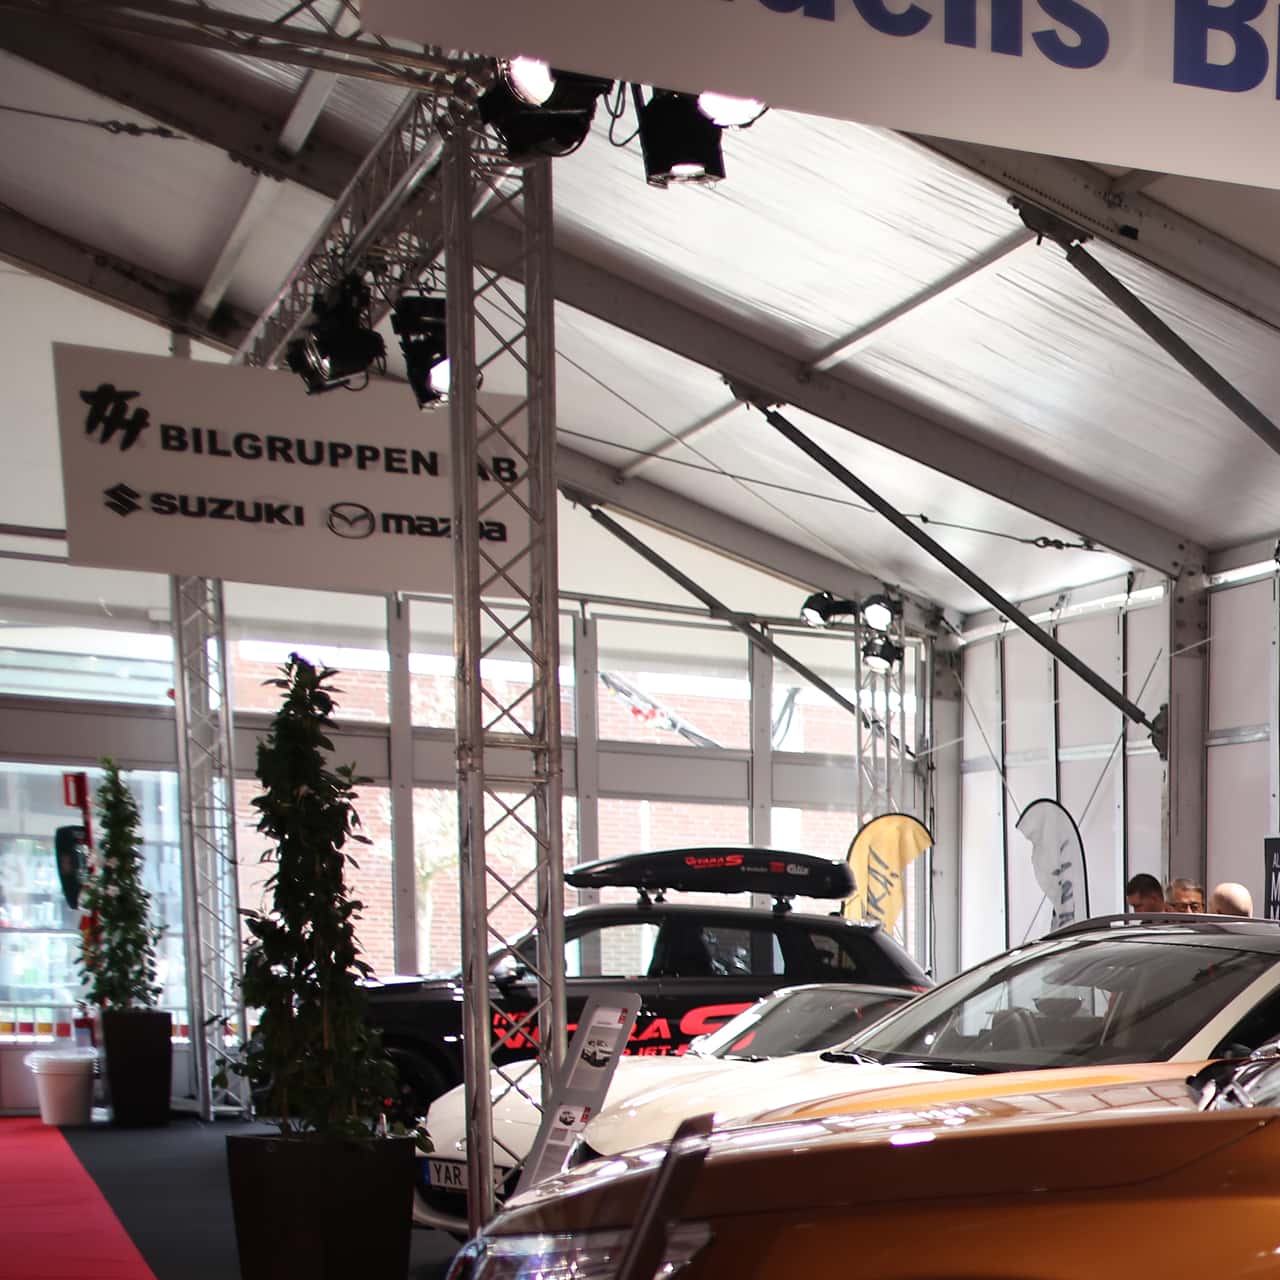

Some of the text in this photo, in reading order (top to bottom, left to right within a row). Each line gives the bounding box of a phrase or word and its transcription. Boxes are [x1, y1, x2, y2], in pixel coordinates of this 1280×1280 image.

[160, 424, 439, 476] BILGRUPPEN
[151, 493, 305, 526] SUZUKI
[382, 512, 507, 542] maza
